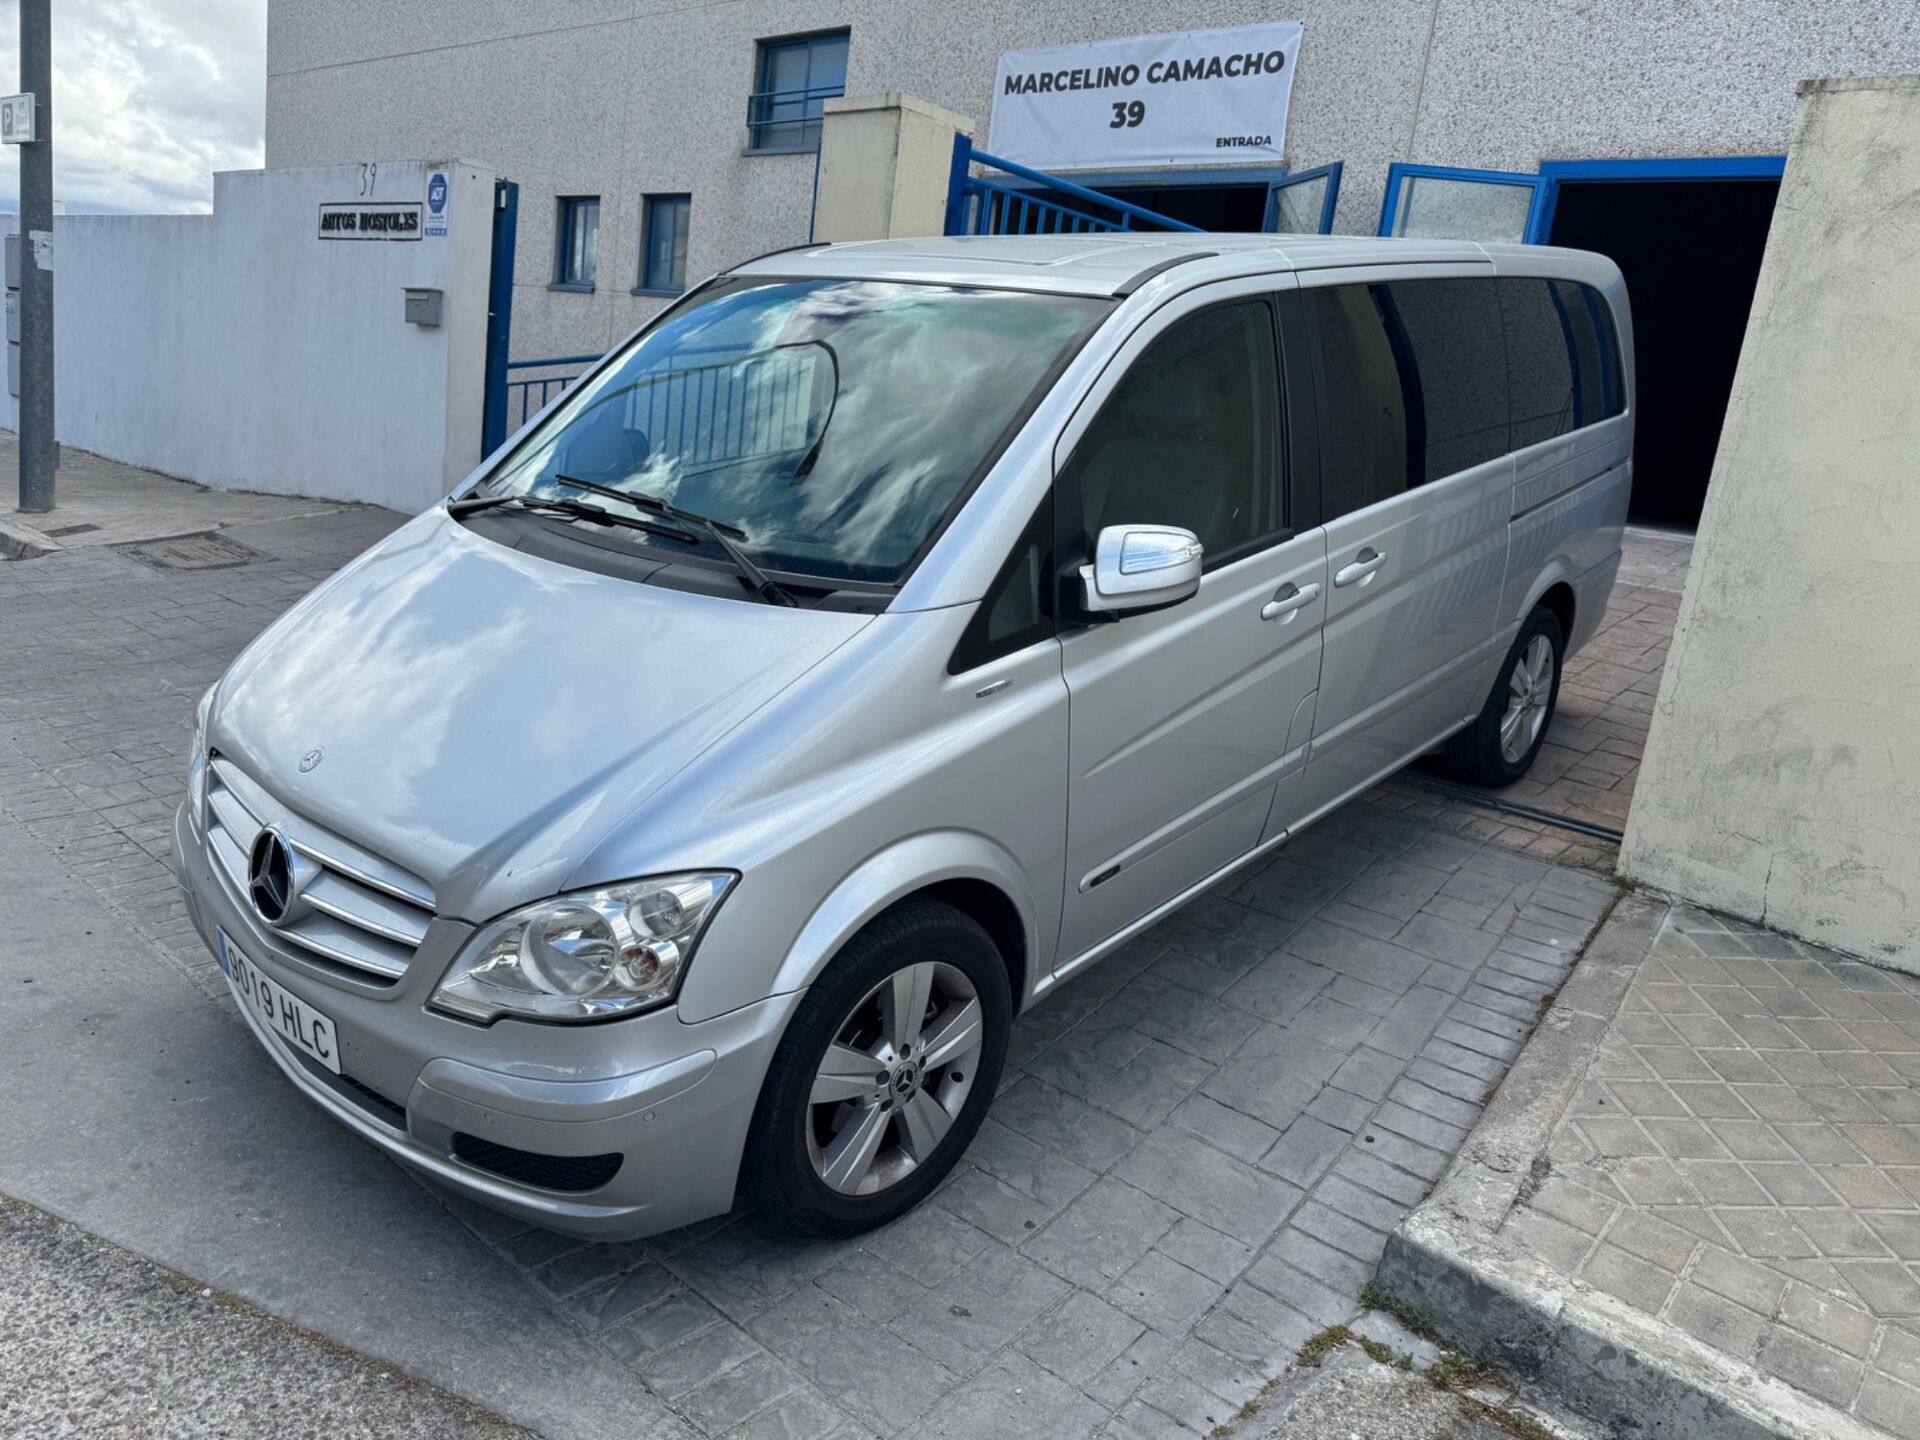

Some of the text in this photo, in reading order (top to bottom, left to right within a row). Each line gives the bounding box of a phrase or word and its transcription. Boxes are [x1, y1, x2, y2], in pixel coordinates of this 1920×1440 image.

[1004, 50, 1285, 95] MARCELINO CAMACHO
[1109, 100, 1146, 128] 39
[1216, 135, 1272, 148] ENTRADA
[360, 163, 377, 196] 39
[431, 186, 445, 201] ADT
[321, 212, 356, 231] AUTOS
[228, 946, 329, 1059] 9019 HLC
